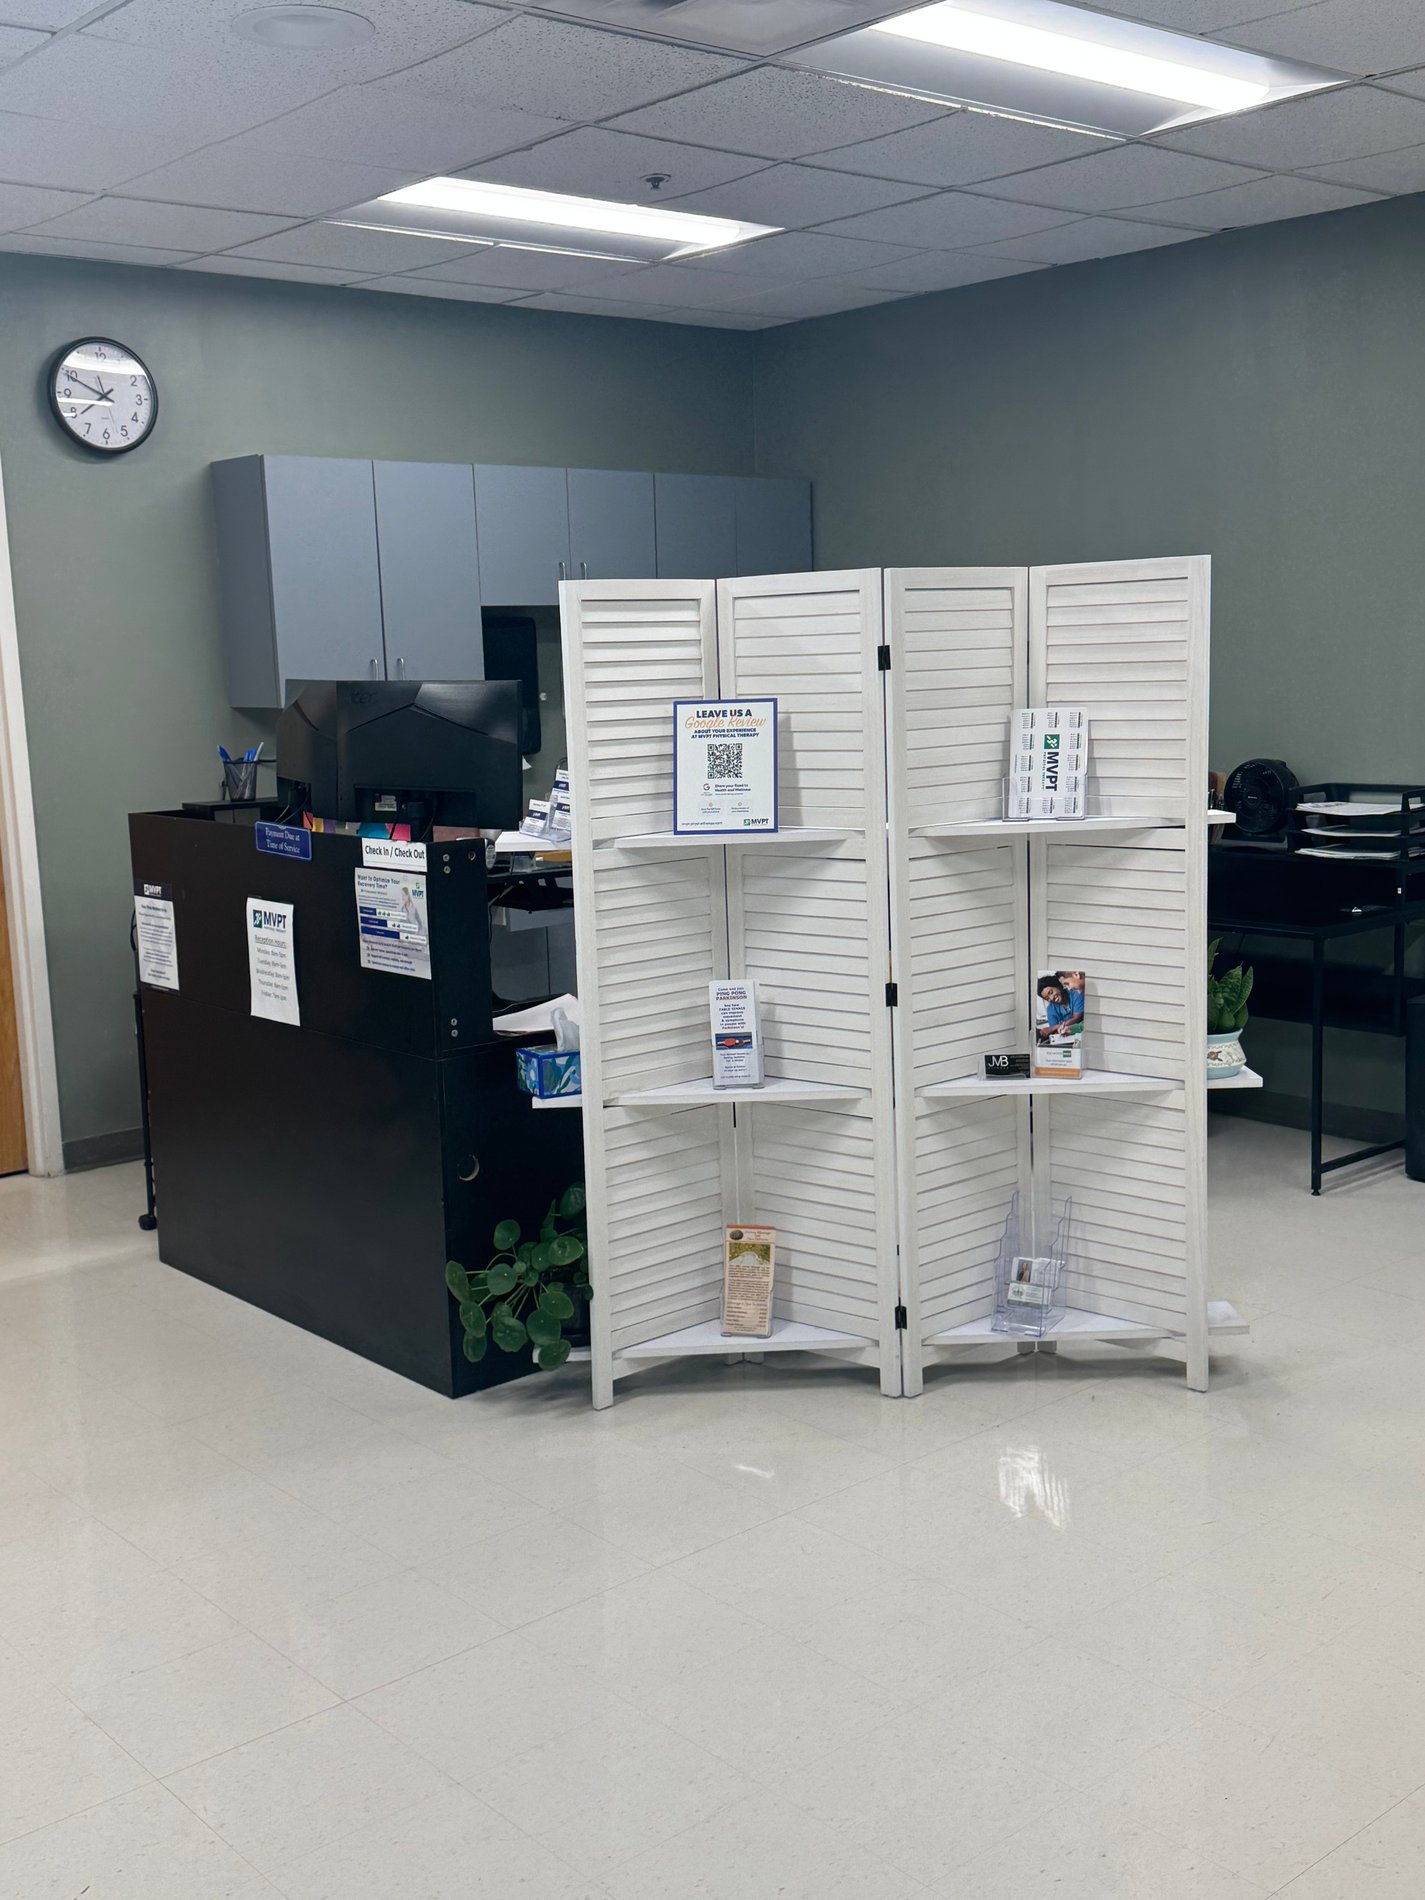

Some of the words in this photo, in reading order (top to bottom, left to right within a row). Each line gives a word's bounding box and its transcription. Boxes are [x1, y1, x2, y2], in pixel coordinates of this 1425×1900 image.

[130, 375, 138, 386] 2
[64, 388, 72, 398] 9
[136, 394, 143, 406] 3
[70, 407, 78, 419] 8
[131, 412, 139, 423] 4
[84, 422, 92, 434] 7
[102, 428, 110, 440] 6
[120, 425, 128, 437] 5
[696, 709, 728, 718] LEAVE
[730, 709, 743, 717] US
[745, 708, 752, 716] A
[685, 716, 725, 729] Google
[728, 714, 766, 728] Review
[1045, 751, 1060, 792] MVPT
[265, 827, 284, 839] Payment
[285, 831, 294, 840] Due
[266, 839, 278, 849] Time
[284, 843, 300, 853] Service
[365, 845, 383, 856] Check
[384, 847, 389, 856] In
[394, 848, 413, 858] Check
[414, 850, 425, 859] Out
[264, 911, 286, 928] MVPT
[988, 1056, 1009, 1067] JMB
